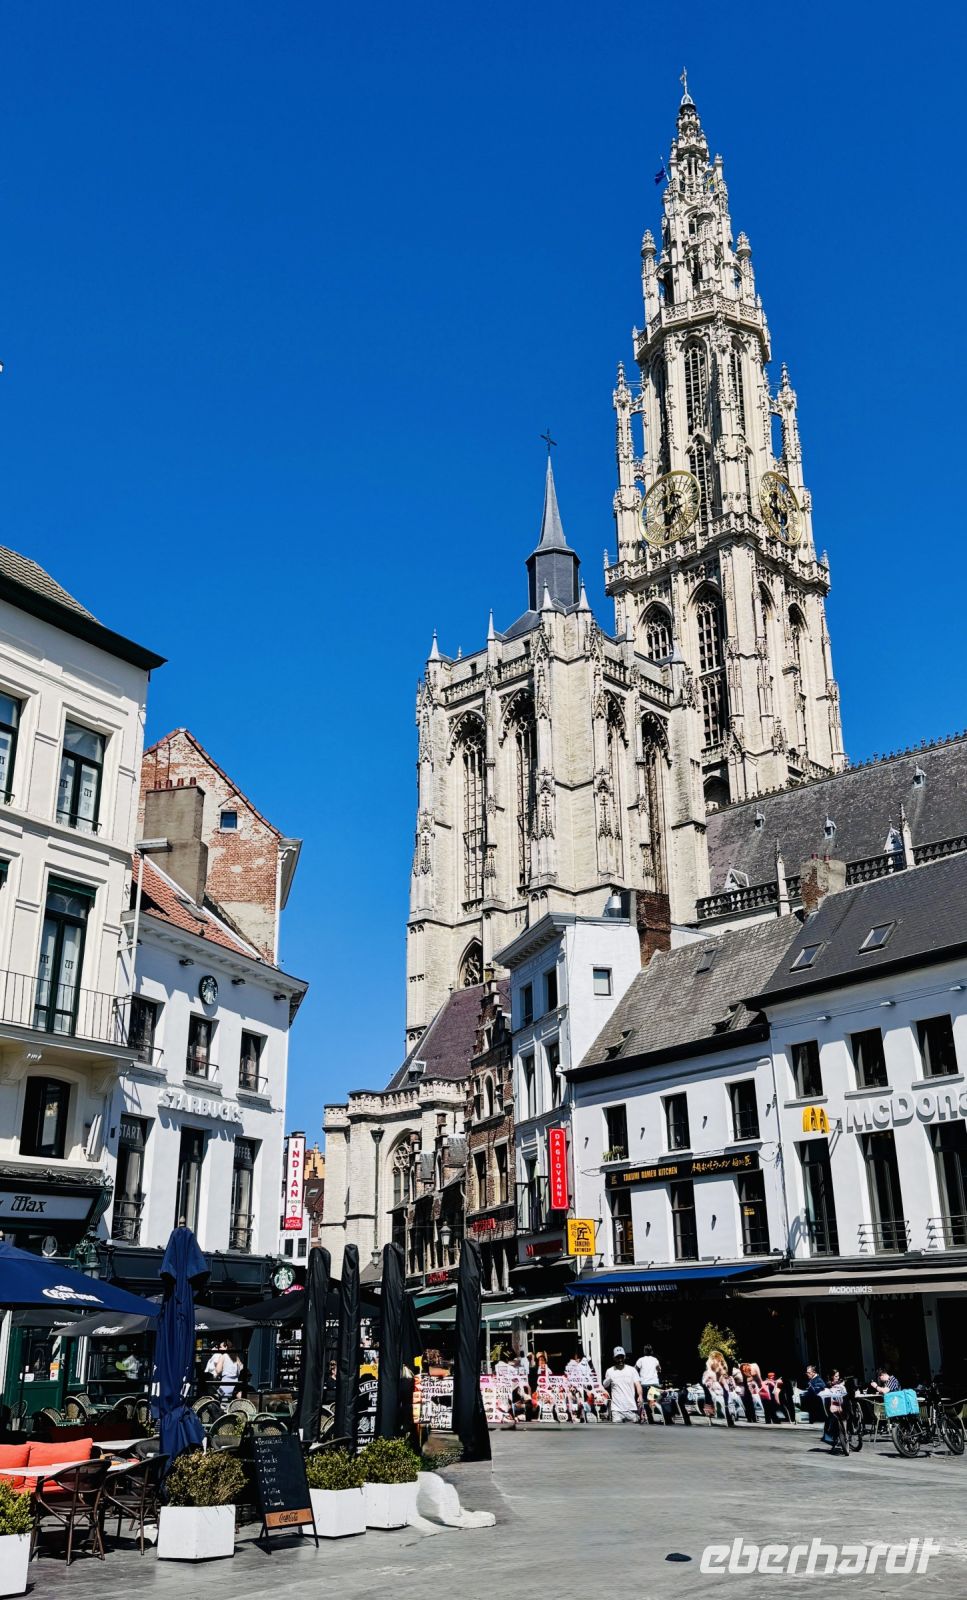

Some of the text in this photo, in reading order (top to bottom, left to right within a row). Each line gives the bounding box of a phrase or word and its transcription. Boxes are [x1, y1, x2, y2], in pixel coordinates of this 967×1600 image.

[158, 1088, 243, 1122] STARBUCKS
[235, 1146, 251, 1160] OFFEE
[290, 1140, 299, 1198] INDIAN
[641, 1169, 657, 1178] RAMEN
[658, 1166, 678, 1177] KITCHEN
